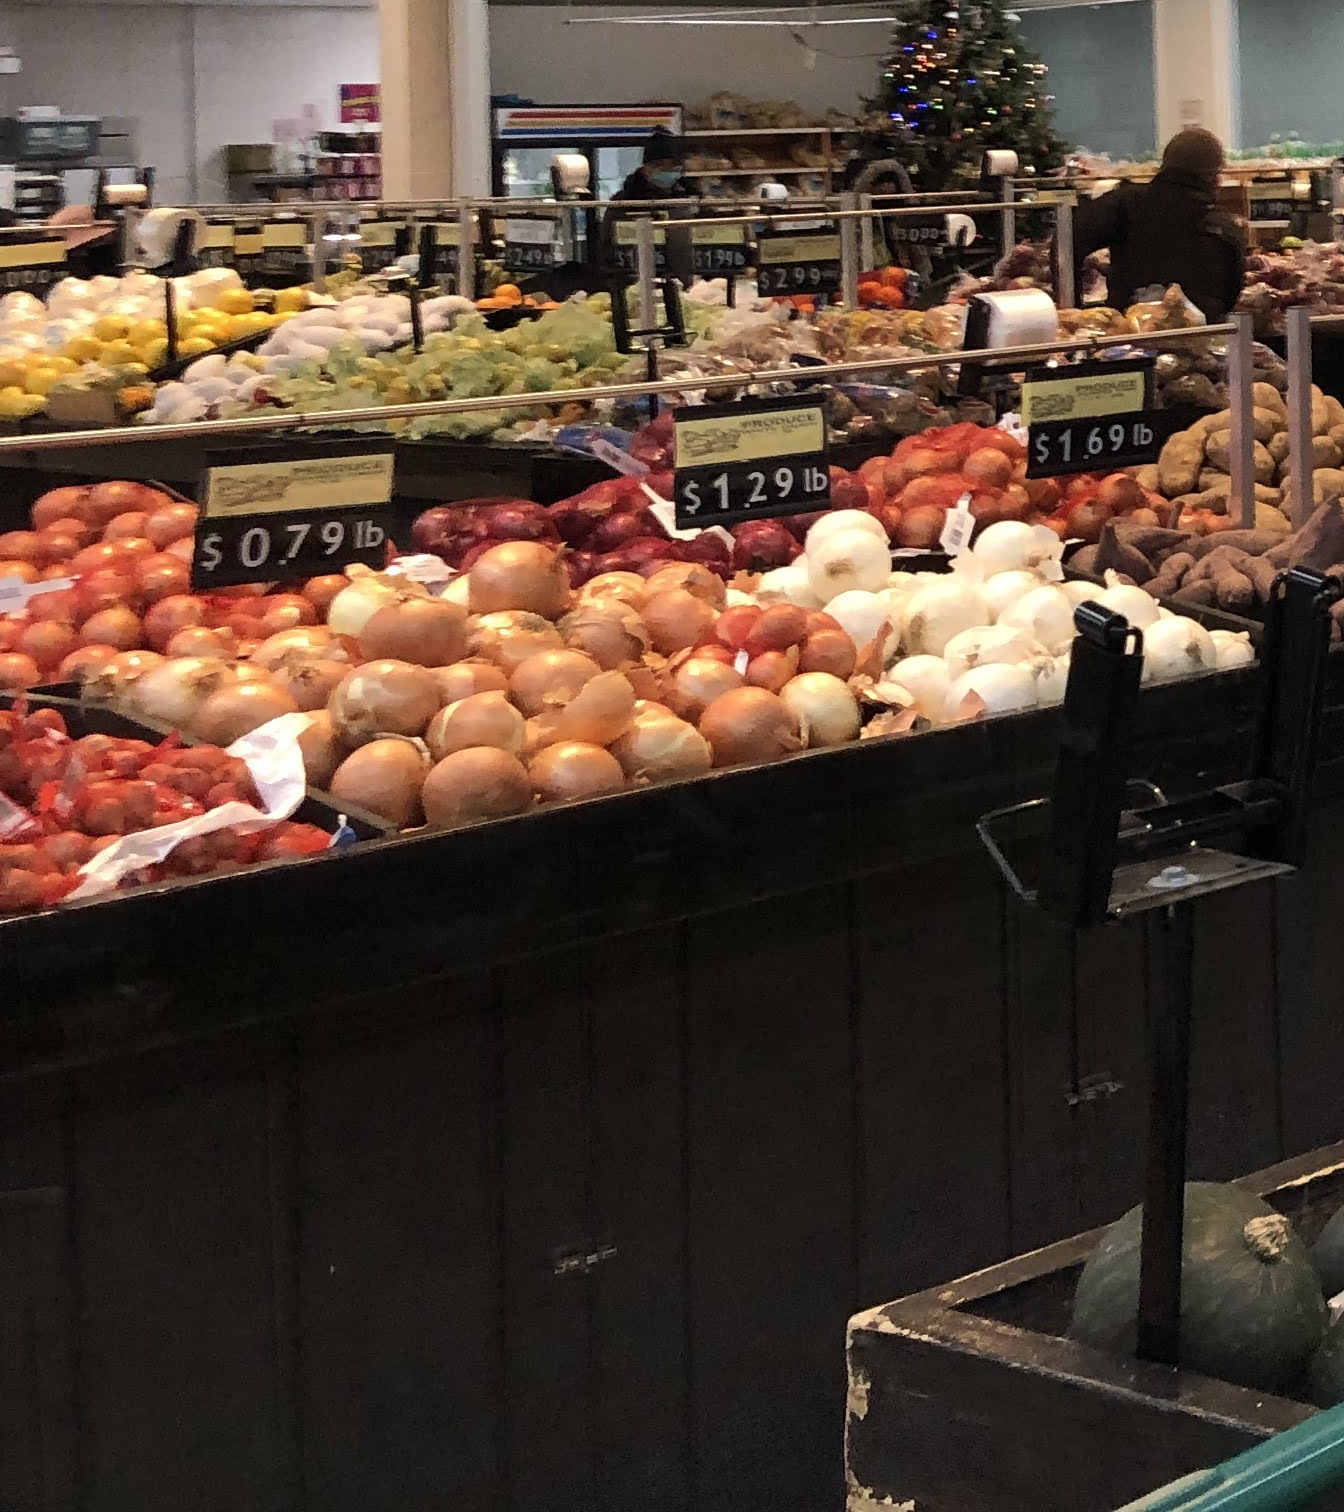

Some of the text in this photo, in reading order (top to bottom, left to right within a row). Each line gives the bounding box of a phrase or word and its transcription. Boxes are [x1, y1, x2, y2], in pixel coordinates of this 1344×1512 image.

[1035, 423, 1154, 464] $1.69 lb
[683, 466, 828, 515] $1.29 lb
[201, 520, 385, 572] $0.79 lb
